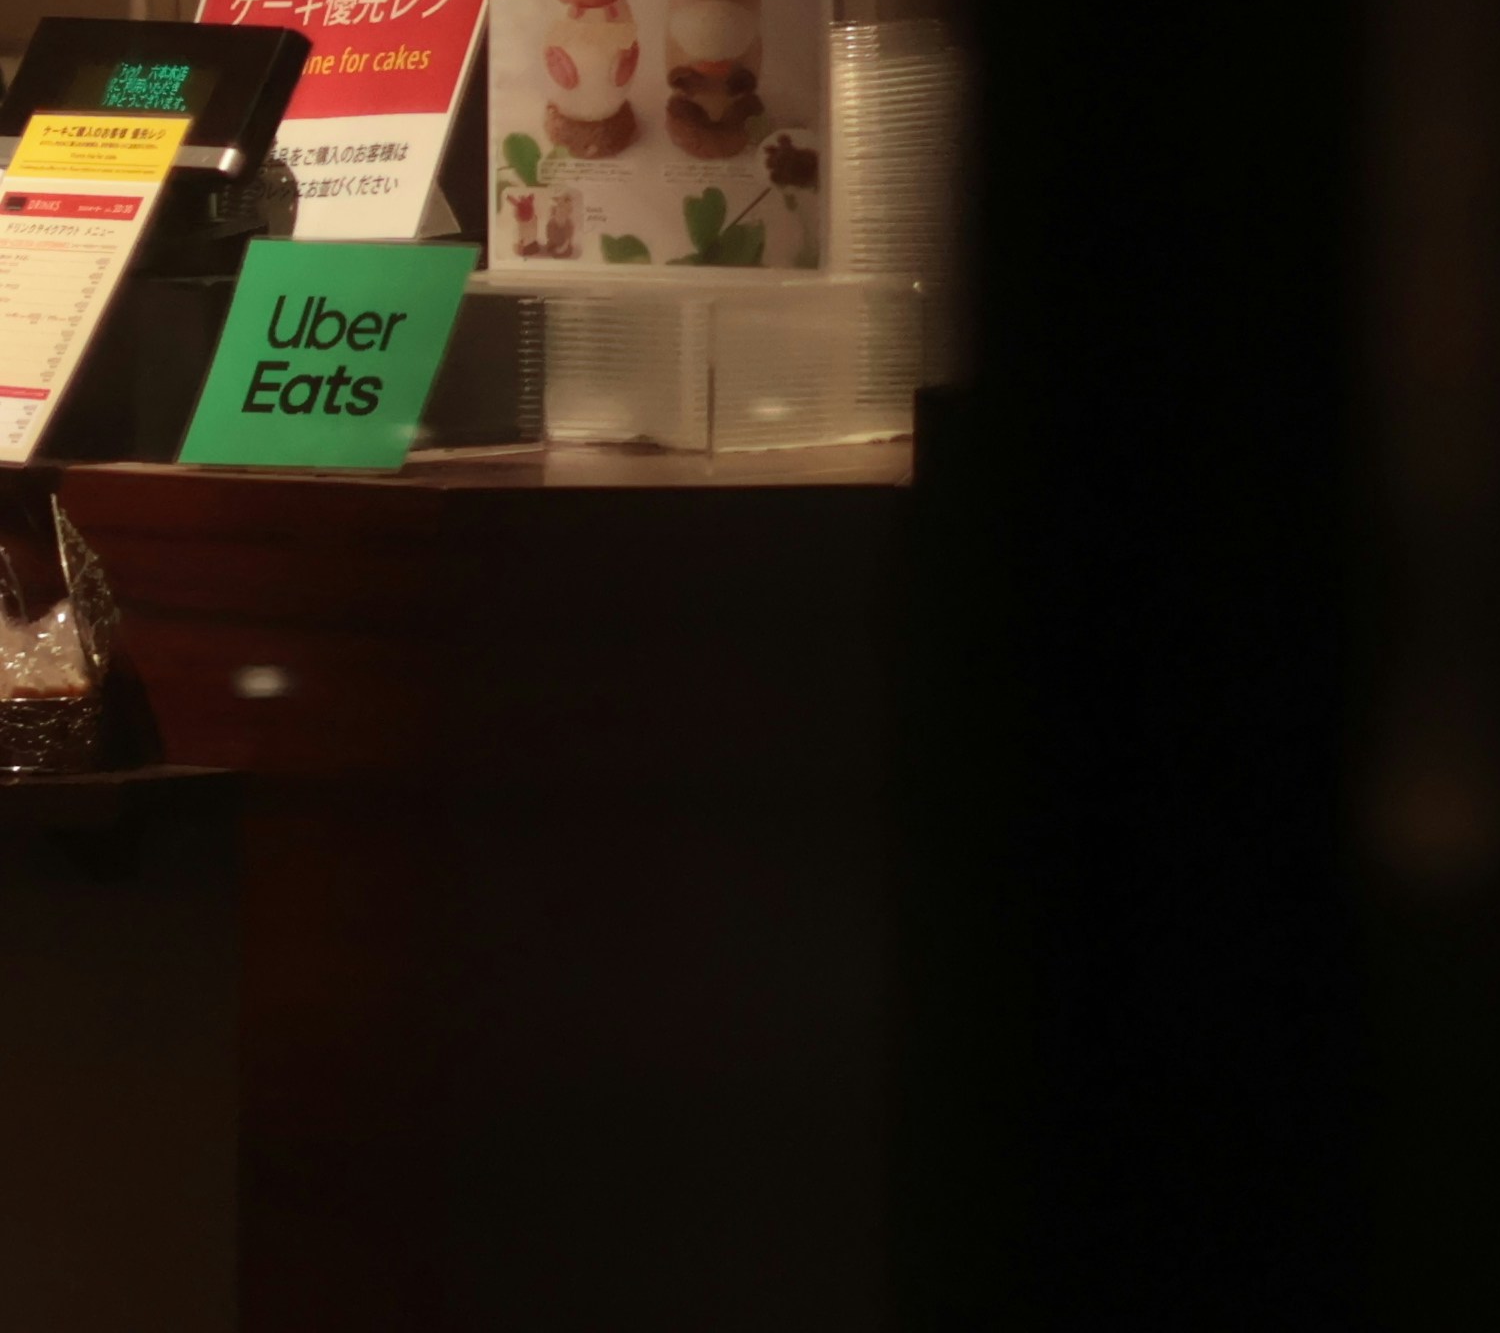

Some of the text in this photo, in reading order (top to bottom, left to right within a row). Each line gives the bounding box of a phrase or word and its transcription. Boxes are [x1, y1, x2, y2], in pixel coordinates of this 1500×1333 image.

[338, 46, 367, 74] for
[372, 43, 432, 72] cakes
[266, 295, 407, 353] Uber
[241, 364, 384, 417] Eats
